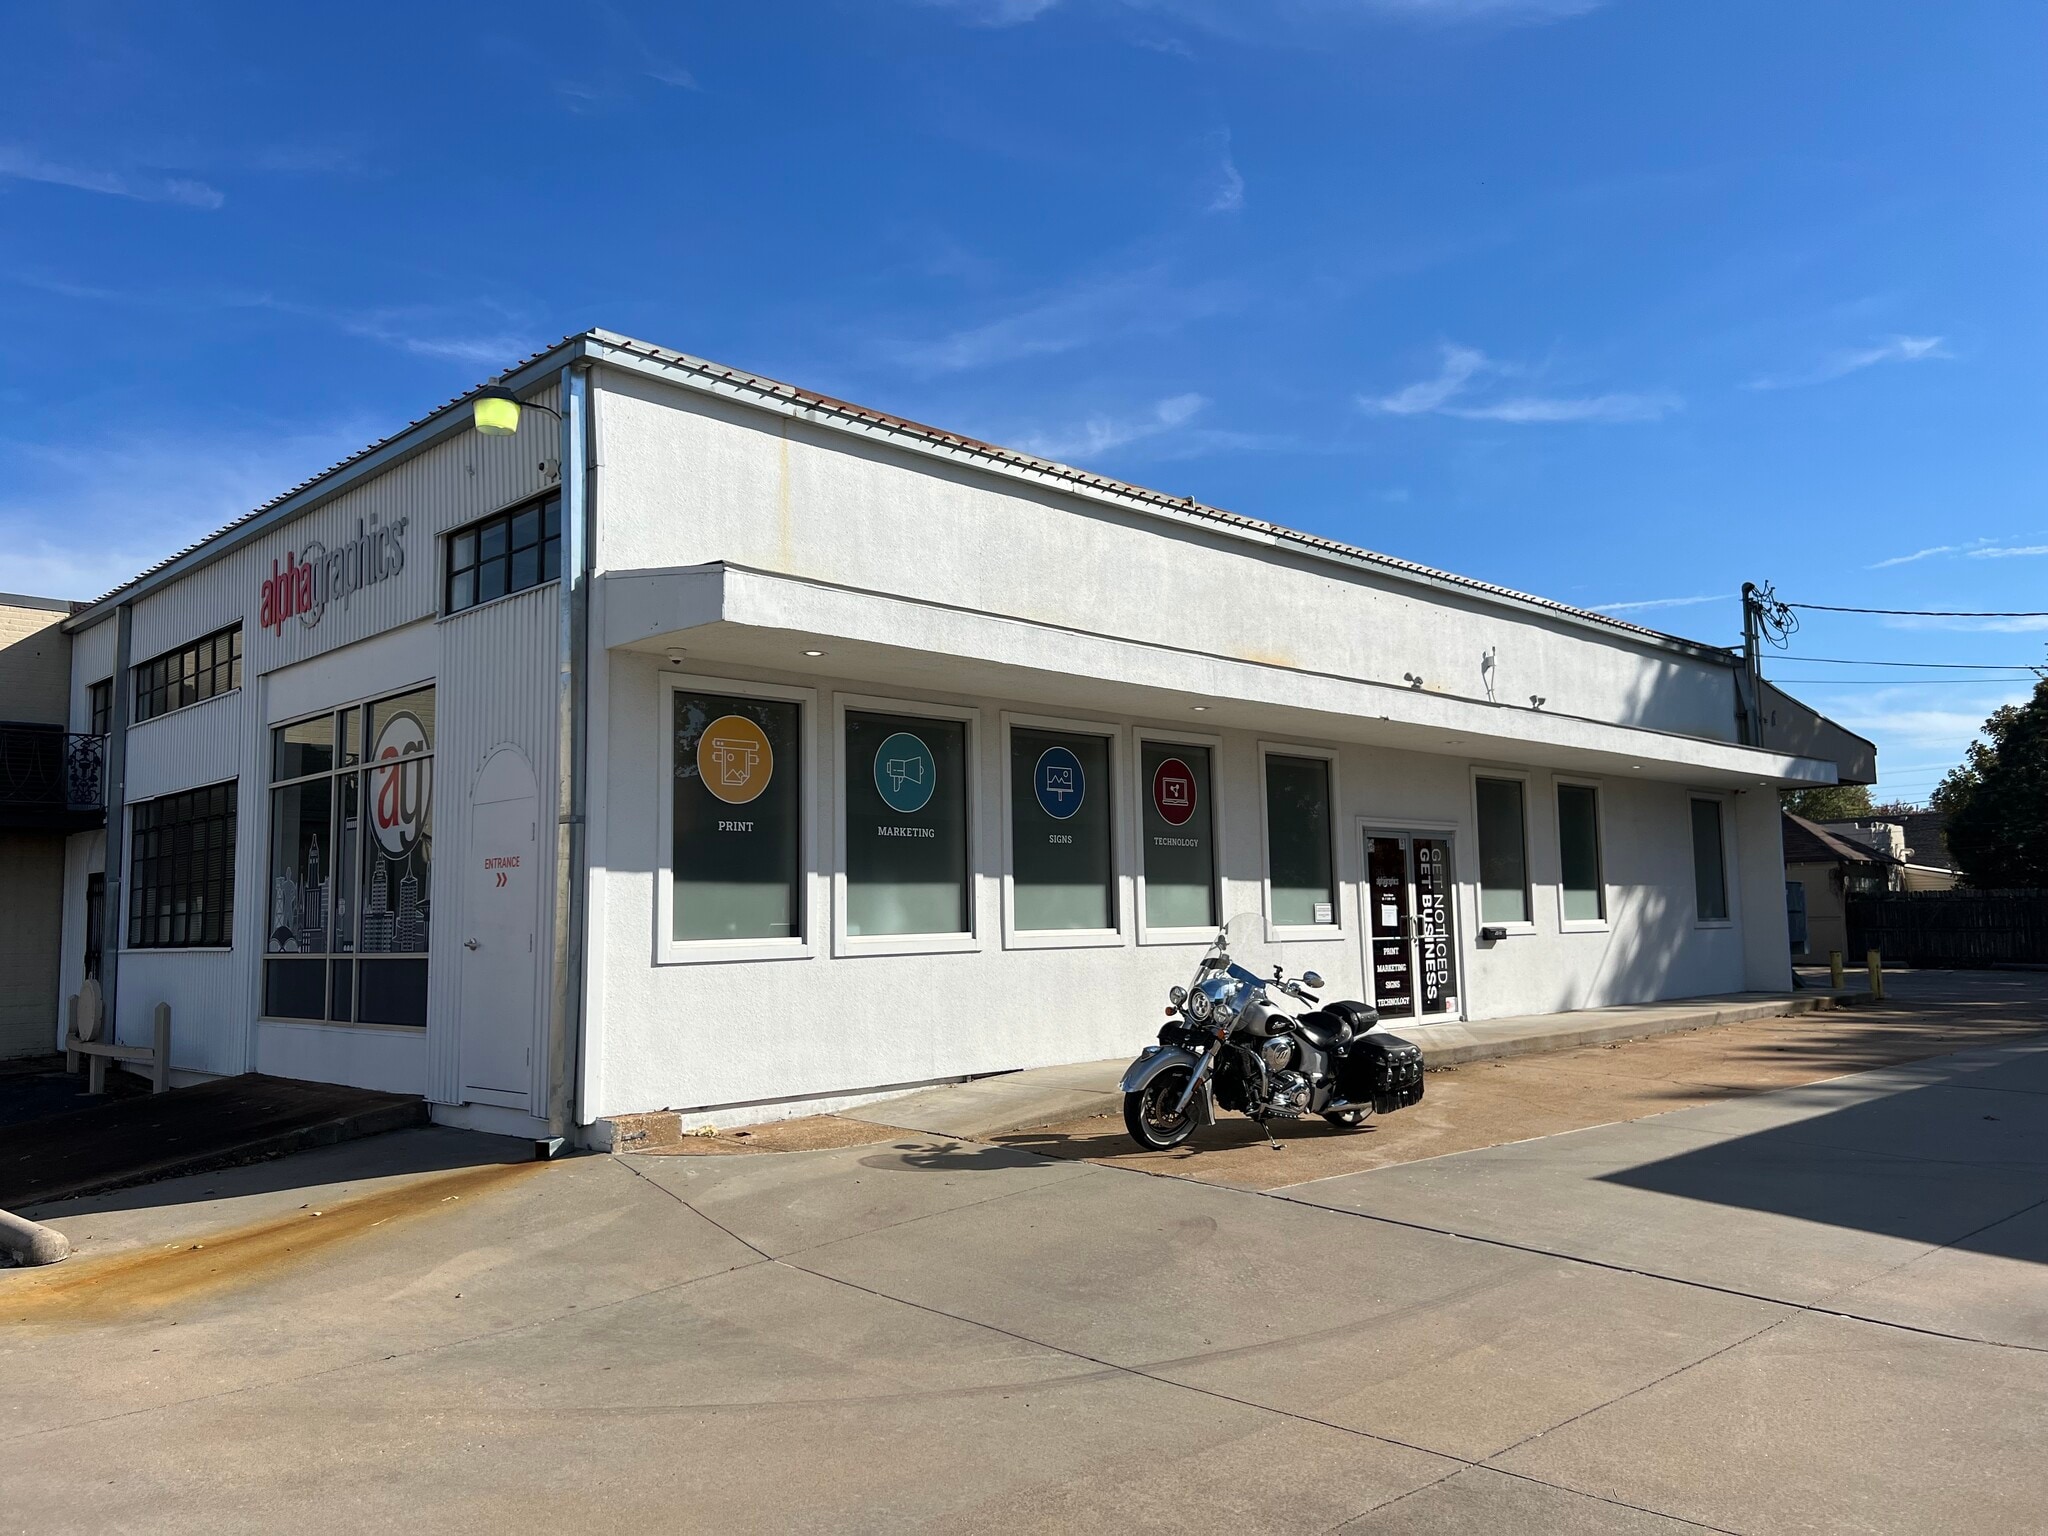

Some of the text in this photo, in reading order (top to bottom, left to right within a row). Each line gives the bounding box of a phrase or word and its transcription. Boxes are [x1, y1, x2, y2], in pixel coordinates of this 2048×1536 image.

[718, 820, 754, 832] PRINT
[878, 826, 935, 838] MARKETING
[1049, 834, 1073, 845] SIGNS
[1153, 836, 1199, 848] TECHNOLOGY
[484, 855, 521, 870] ENTRANCE
[1431, 848, 1448, 988] GET NOTICED.
[1420, 848, 1438, 1004] GET BUSINESS.
[1383, 947, 1400, 956] PRINT
[1376, 963, 1407, 973] MARKETING
[1385, 980, 1401, 989] SIGNS
[1377, 996, 1410, 1007] TECHNOLOGY
